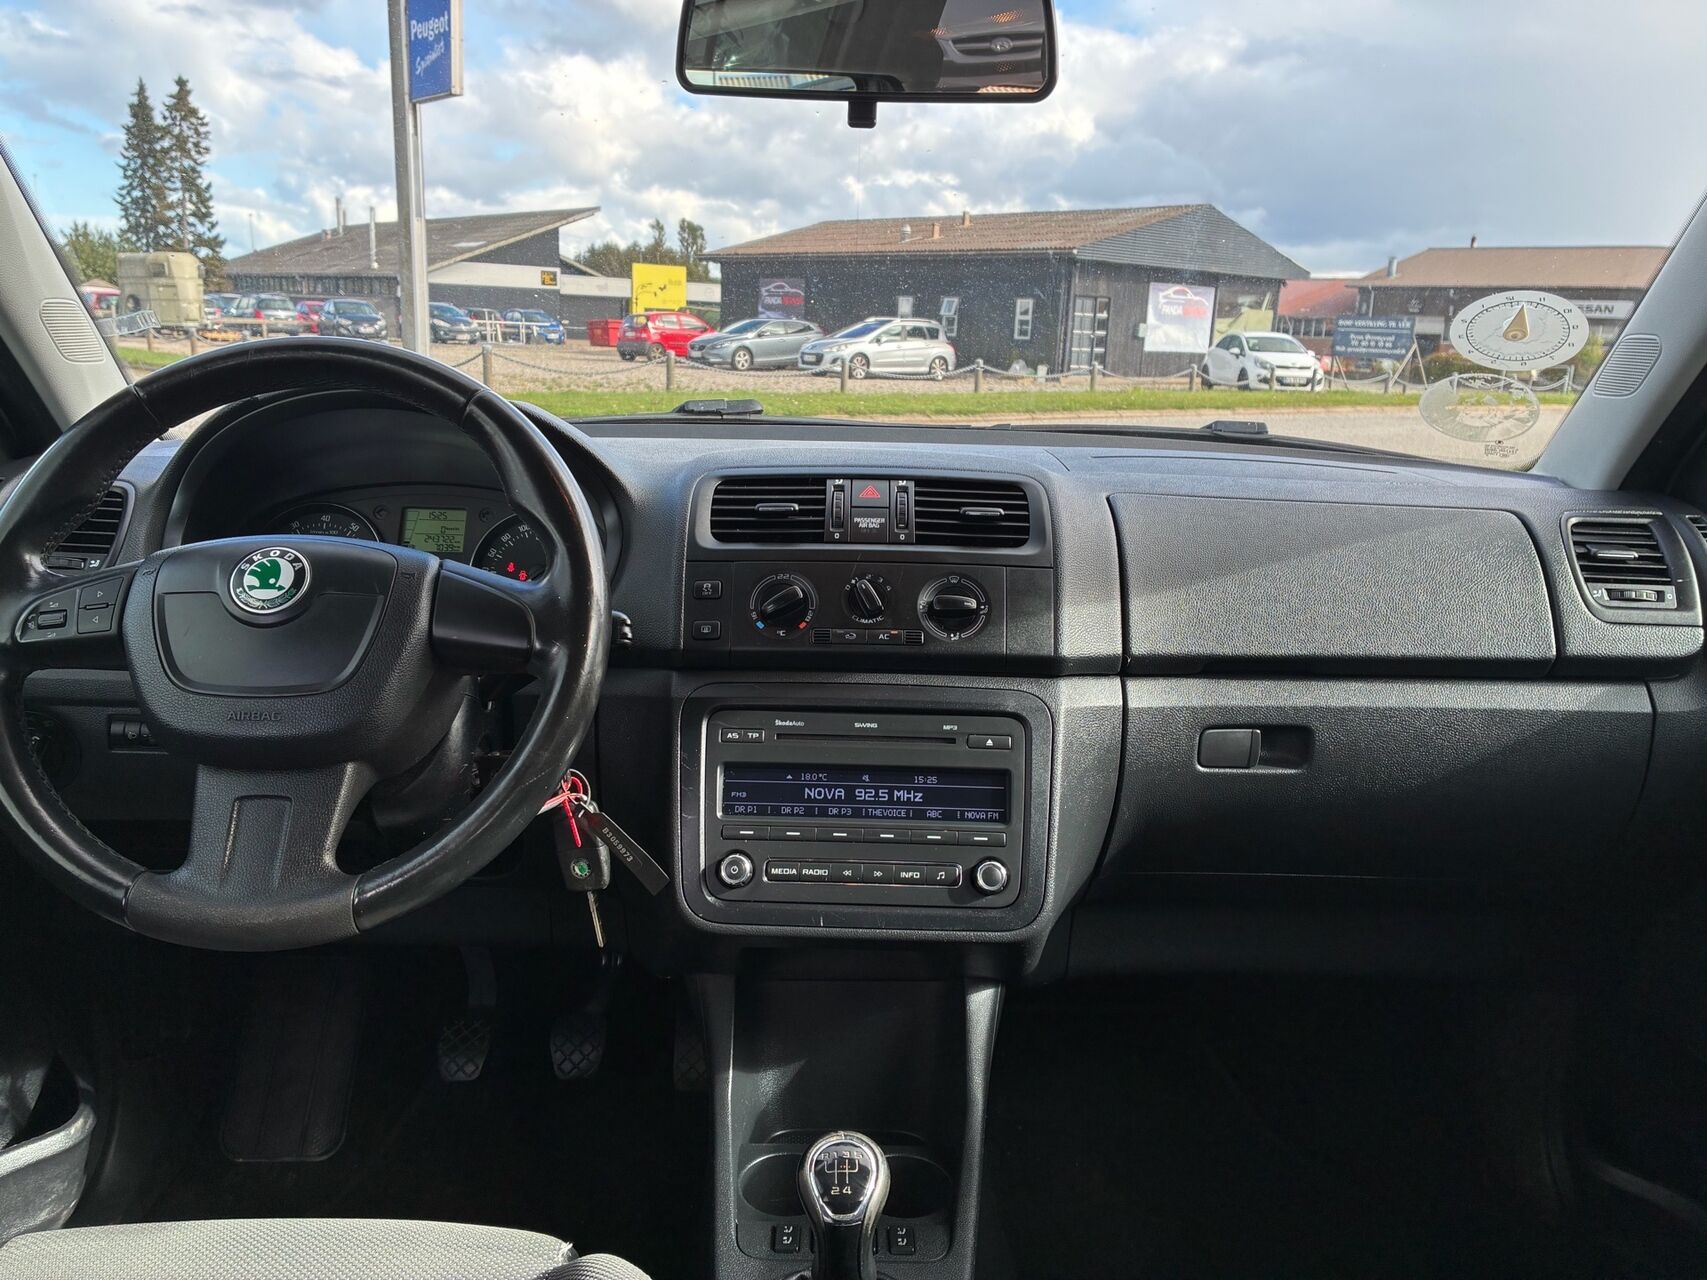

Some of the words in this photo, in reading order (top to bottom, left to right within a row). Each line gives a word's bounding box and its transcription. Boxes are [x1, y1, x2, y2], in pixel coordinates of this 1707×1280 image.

[410, 11, 449, 40] Peugeot
[349, 522, 360, 532] 50
[501, 533, 511, 543] 80
[487, 548, 497, 558] 60
[851, 615, 885, 624] CLIMATIC
[227, 710, 281, 721] AIRBAG
[914, 776, 938, 784] 15:25
[804, 787, 845, 800] NOVA
[855, 788, 889, 801] 92.5
[893, 789, 923, 802] MHz
[735, 805, 745, 813] DR
[747, 805, 757, 813] P1
[781, 806, 792, 814] DR
[793, 806, 805, 814] P2
[828, 807, 839, 815] DR
[841, 808, 852, 816] P3
[868, 809, 907, 817] THEVOICE
[926, 810, 942, 818] ABC
[964, 811, 986, 819] NOVA
[988, 812, 999, 820] FM
[771, 867, 797, 876] MEDIA
[802, 868, 829, 876] RADIO
[900, 871, 920, 879] INFO
[831, 1186, 841, 1195] 2
[842, 1186, 852, 1195] 4
